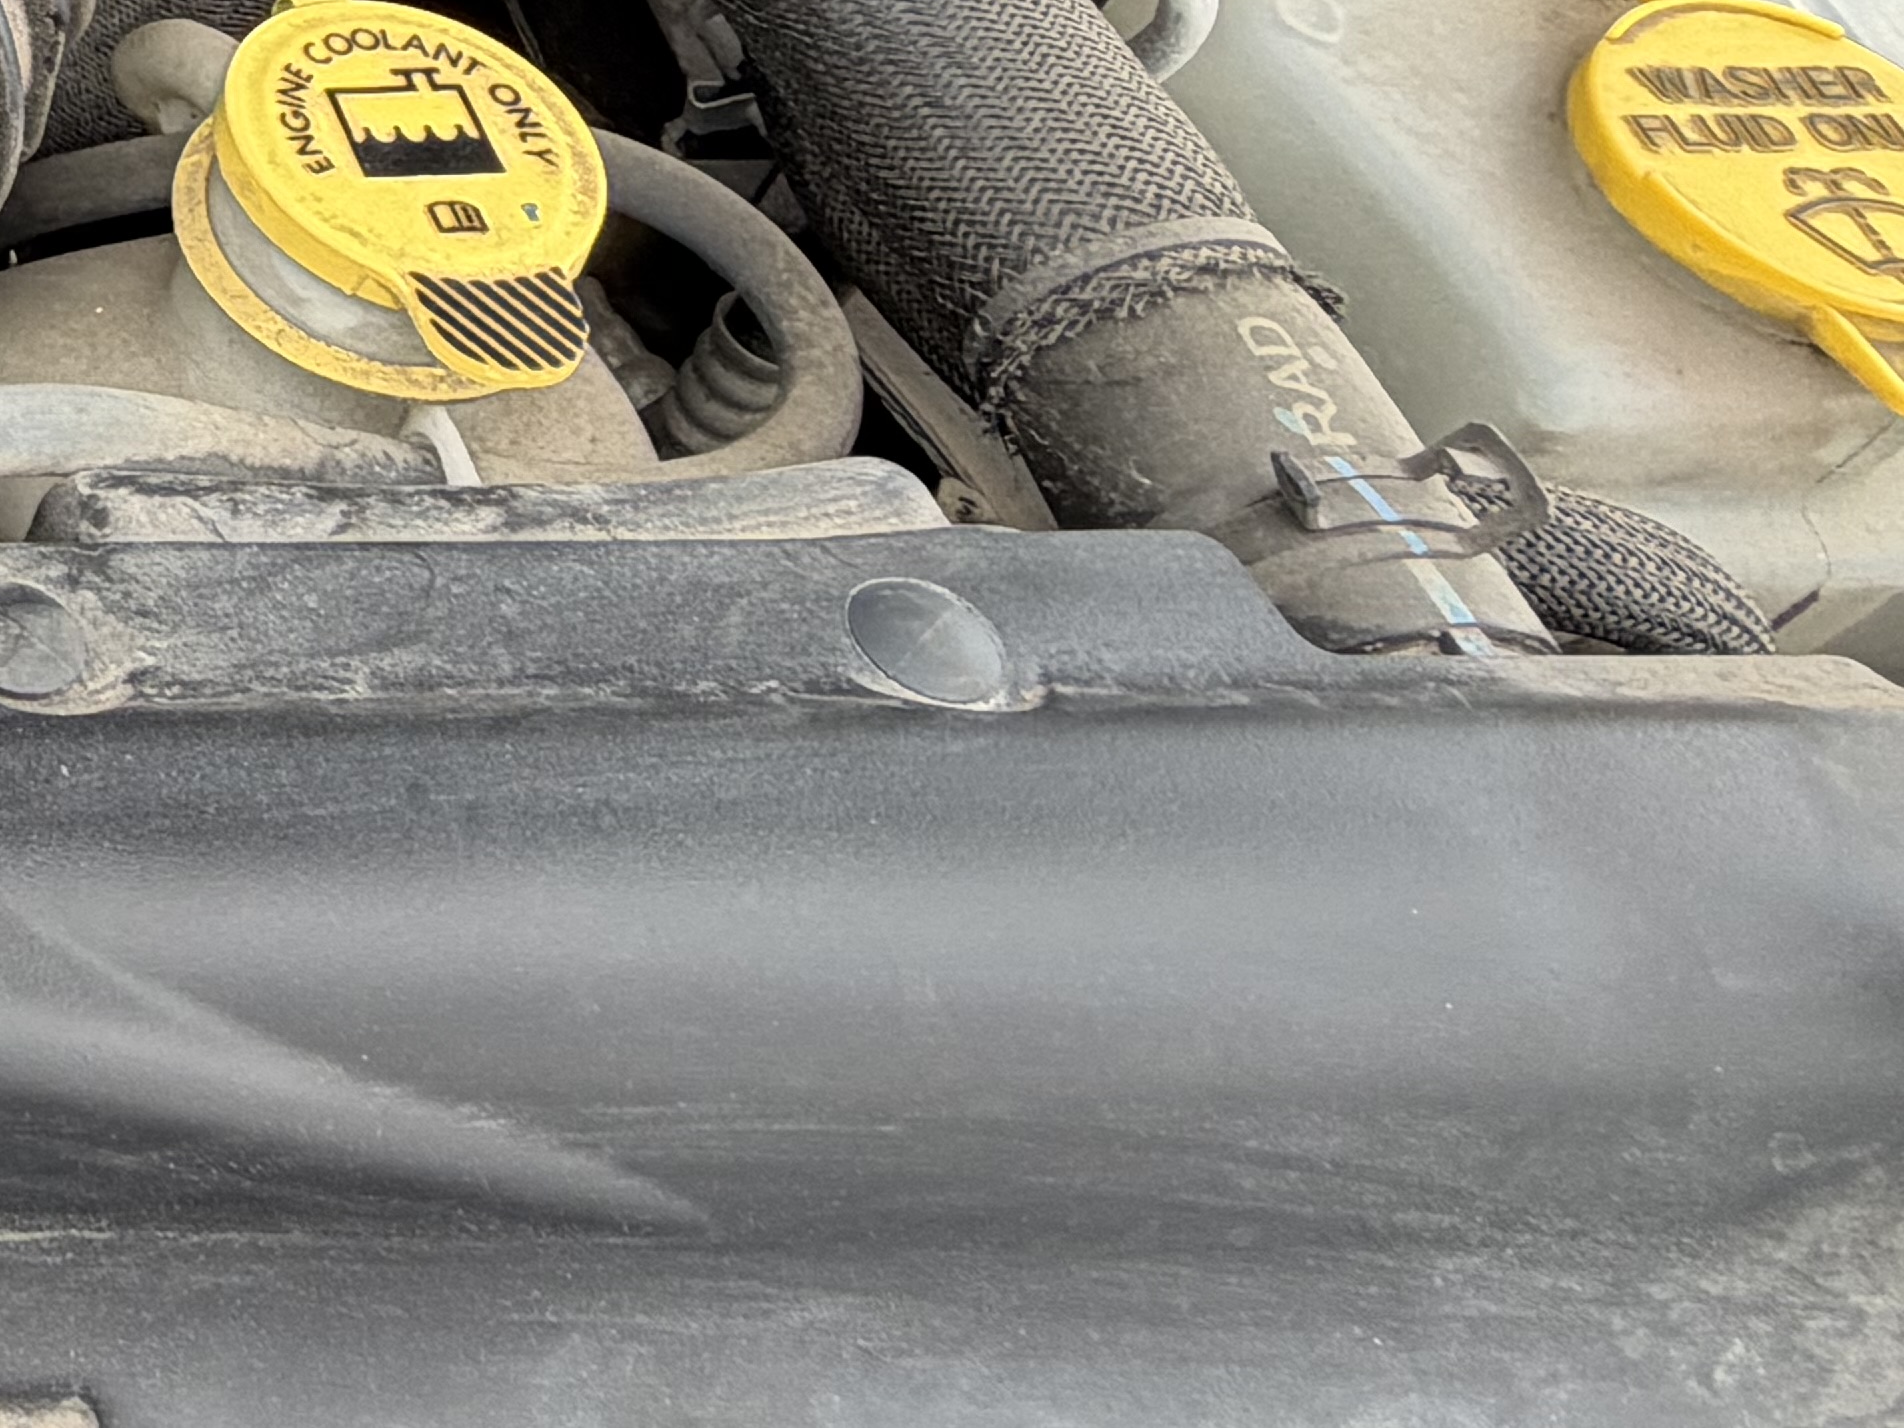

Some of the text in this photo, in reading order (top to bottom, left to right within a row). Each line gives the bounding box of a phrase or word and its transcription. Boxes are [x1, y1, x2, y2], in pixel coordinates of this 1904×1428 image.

[277, 27, 560, 176] ENGINE COOLANT ONLY
[1626, 65, 1894, 107] WASHER
[1621, 114, 1798, 154] FLUID
[1236, 315, 1357, 448] RAD
